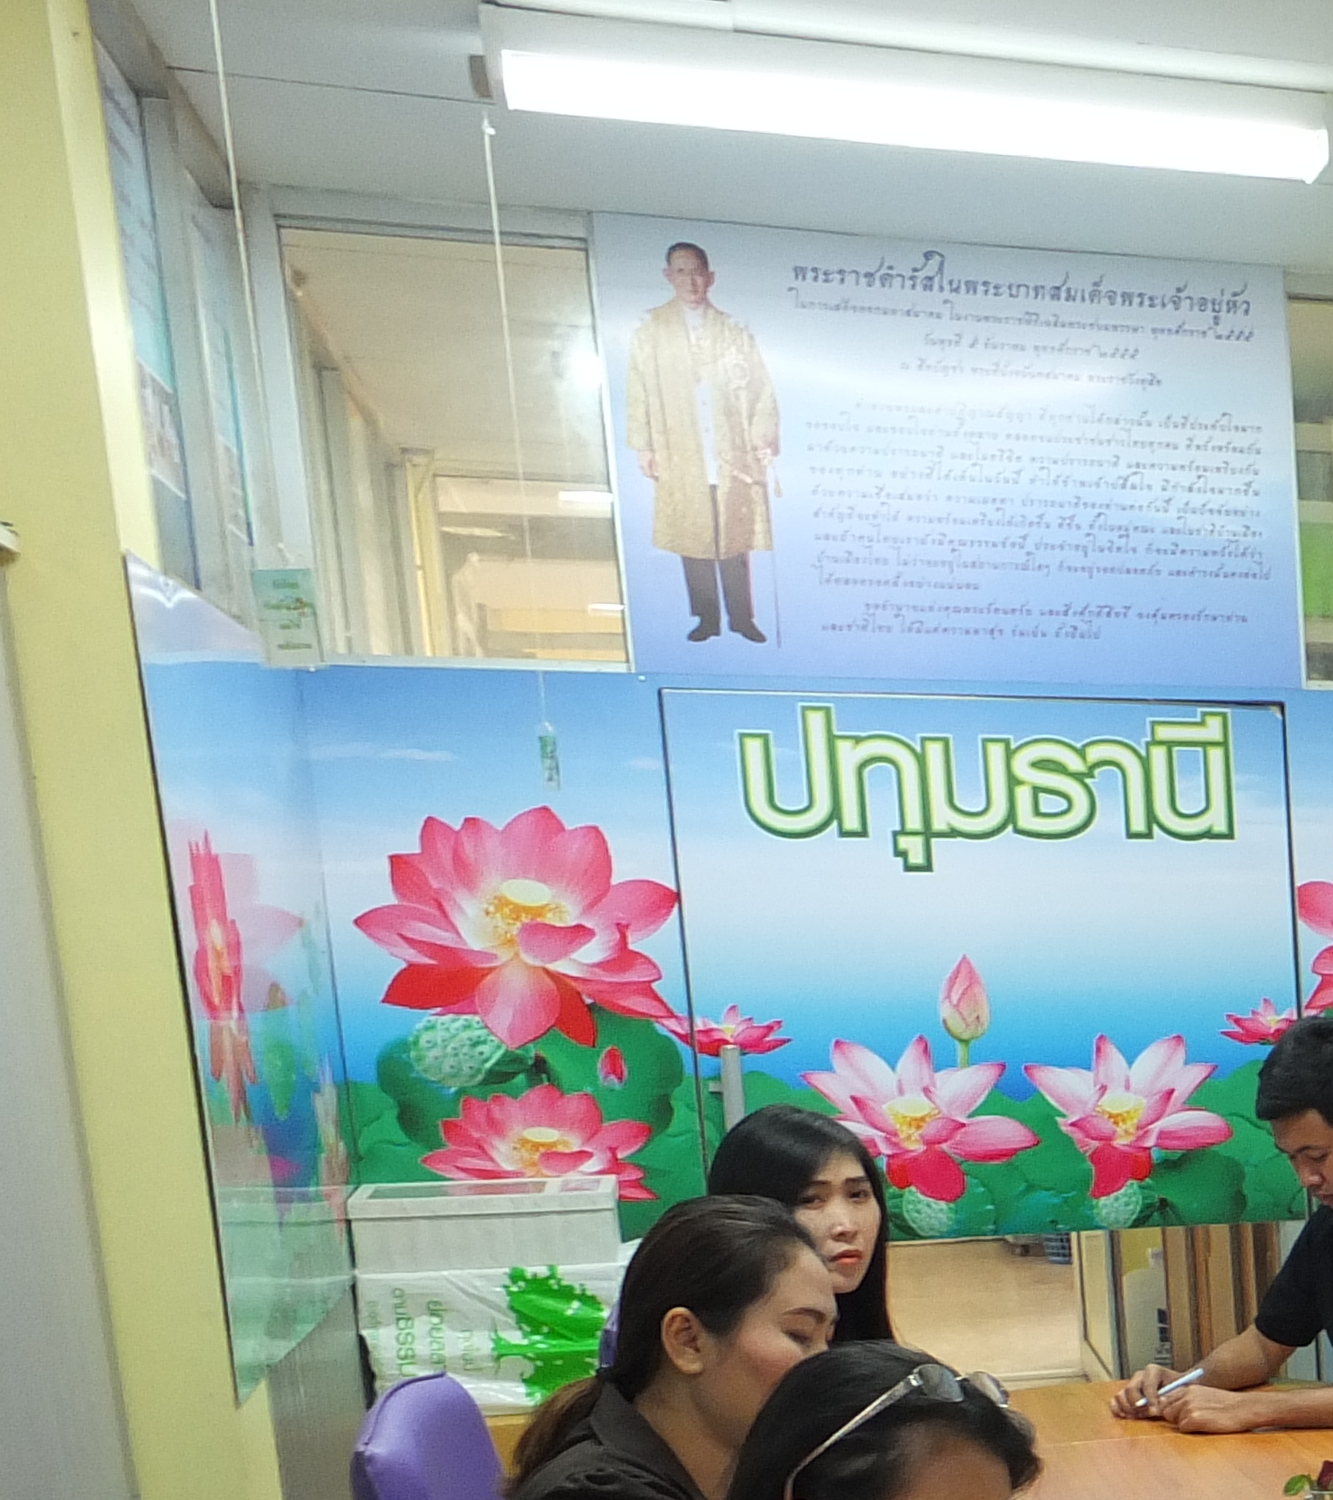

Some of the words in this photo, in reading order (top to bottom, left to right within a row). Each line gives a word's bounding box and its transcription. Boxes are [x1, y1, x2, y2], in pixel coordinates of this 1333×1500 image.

[793, 250, 1251, 326] พระราชดำรัสในพระบาทสมเด็จพระเจ้าอยู่หัว
[736, 703, 1237, 873] ปทุมธานี
